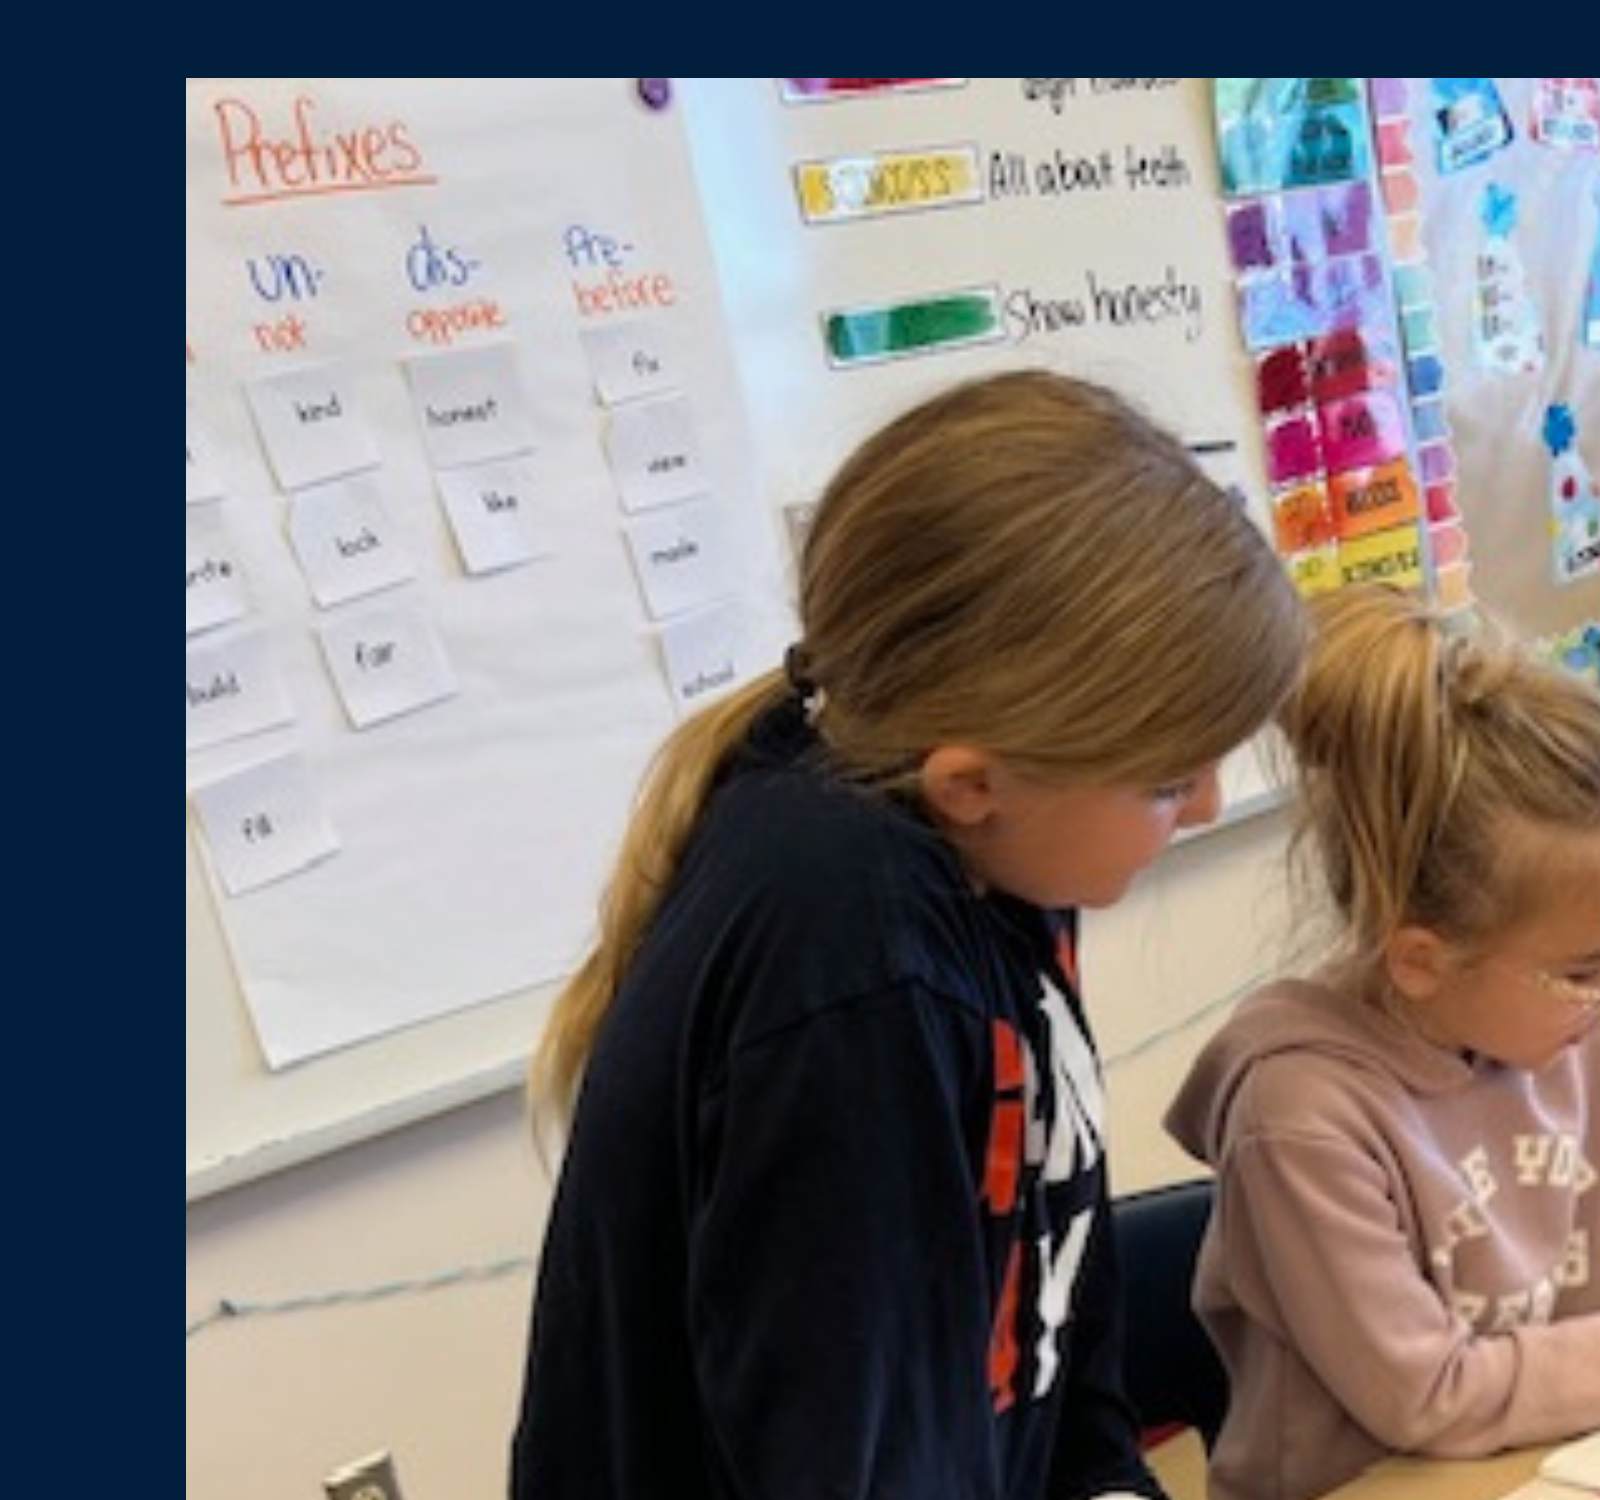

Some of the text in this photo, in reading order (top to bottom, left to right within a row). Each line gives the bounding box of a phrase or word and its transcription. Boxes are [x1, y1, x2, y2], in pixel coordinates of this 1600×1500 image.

[213, 93, 422, 185] Prefixes
[989, 151, 1031, 198] All
[570, 265, 677, 316] before
[1006, 266, 1202, 343] Show honesty
